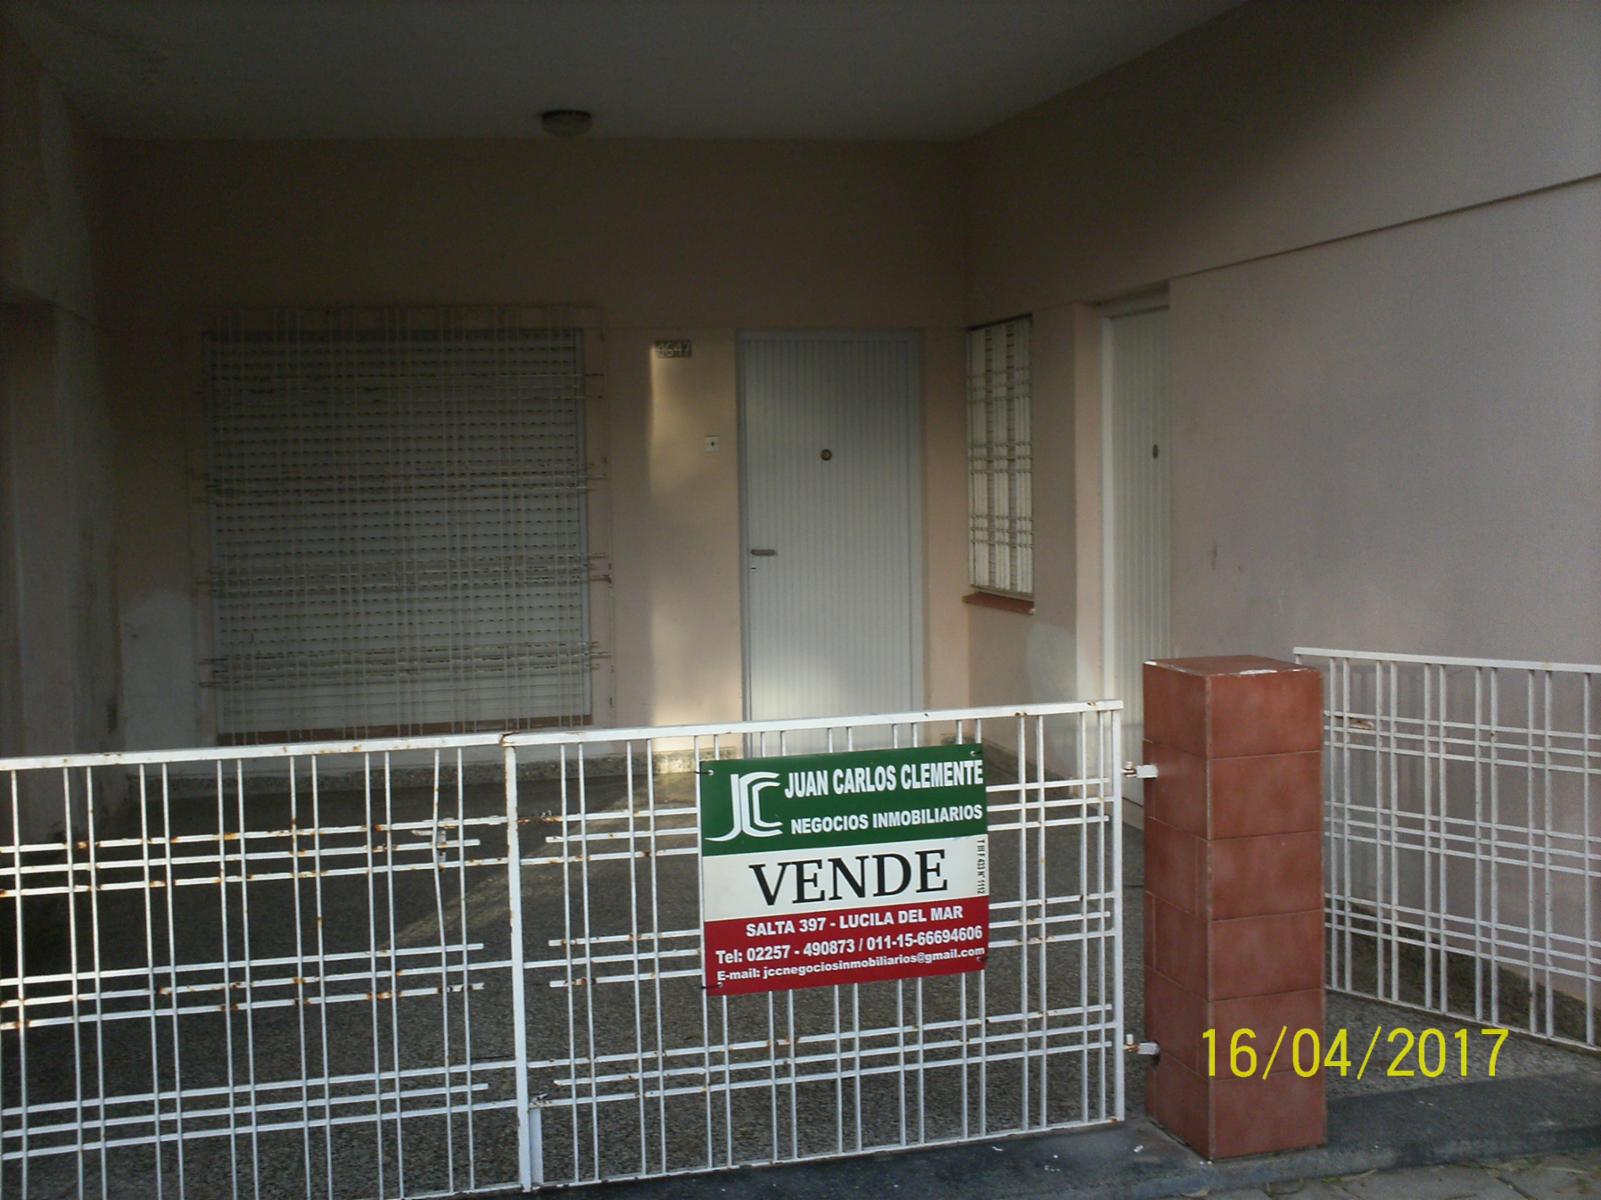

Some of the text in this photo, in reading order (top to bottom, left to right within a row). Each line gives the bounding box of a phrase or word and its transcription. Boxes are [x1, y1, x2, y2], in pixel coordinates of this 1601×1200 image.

[784, 759, 984, 798] JUAN CARLOS CLEMENTE
[791, 804, 983, 835] NEGOCIOS INMOBILIARIOS
[748, 849, 948, 906] VENDE
[746, 920, 795, 937] SALTA
[799, 917, 827, 933] 397
[839, 911, 895, 929] LUCILA
[898, 909, 927, 924] DEL
[930, 905, 964, 921] MAR
[715, 949, 743, 964] Tel:
[746, 944, 791, 962] 02257
[803, 939, 855, 957] 490873
[858, 937, 863, 952] /
[866, 925, 983, 951] 011-15-66694606
[717, 947, 985, 981] E-mail: jccnegociosinmobiliarios@gmail.com
